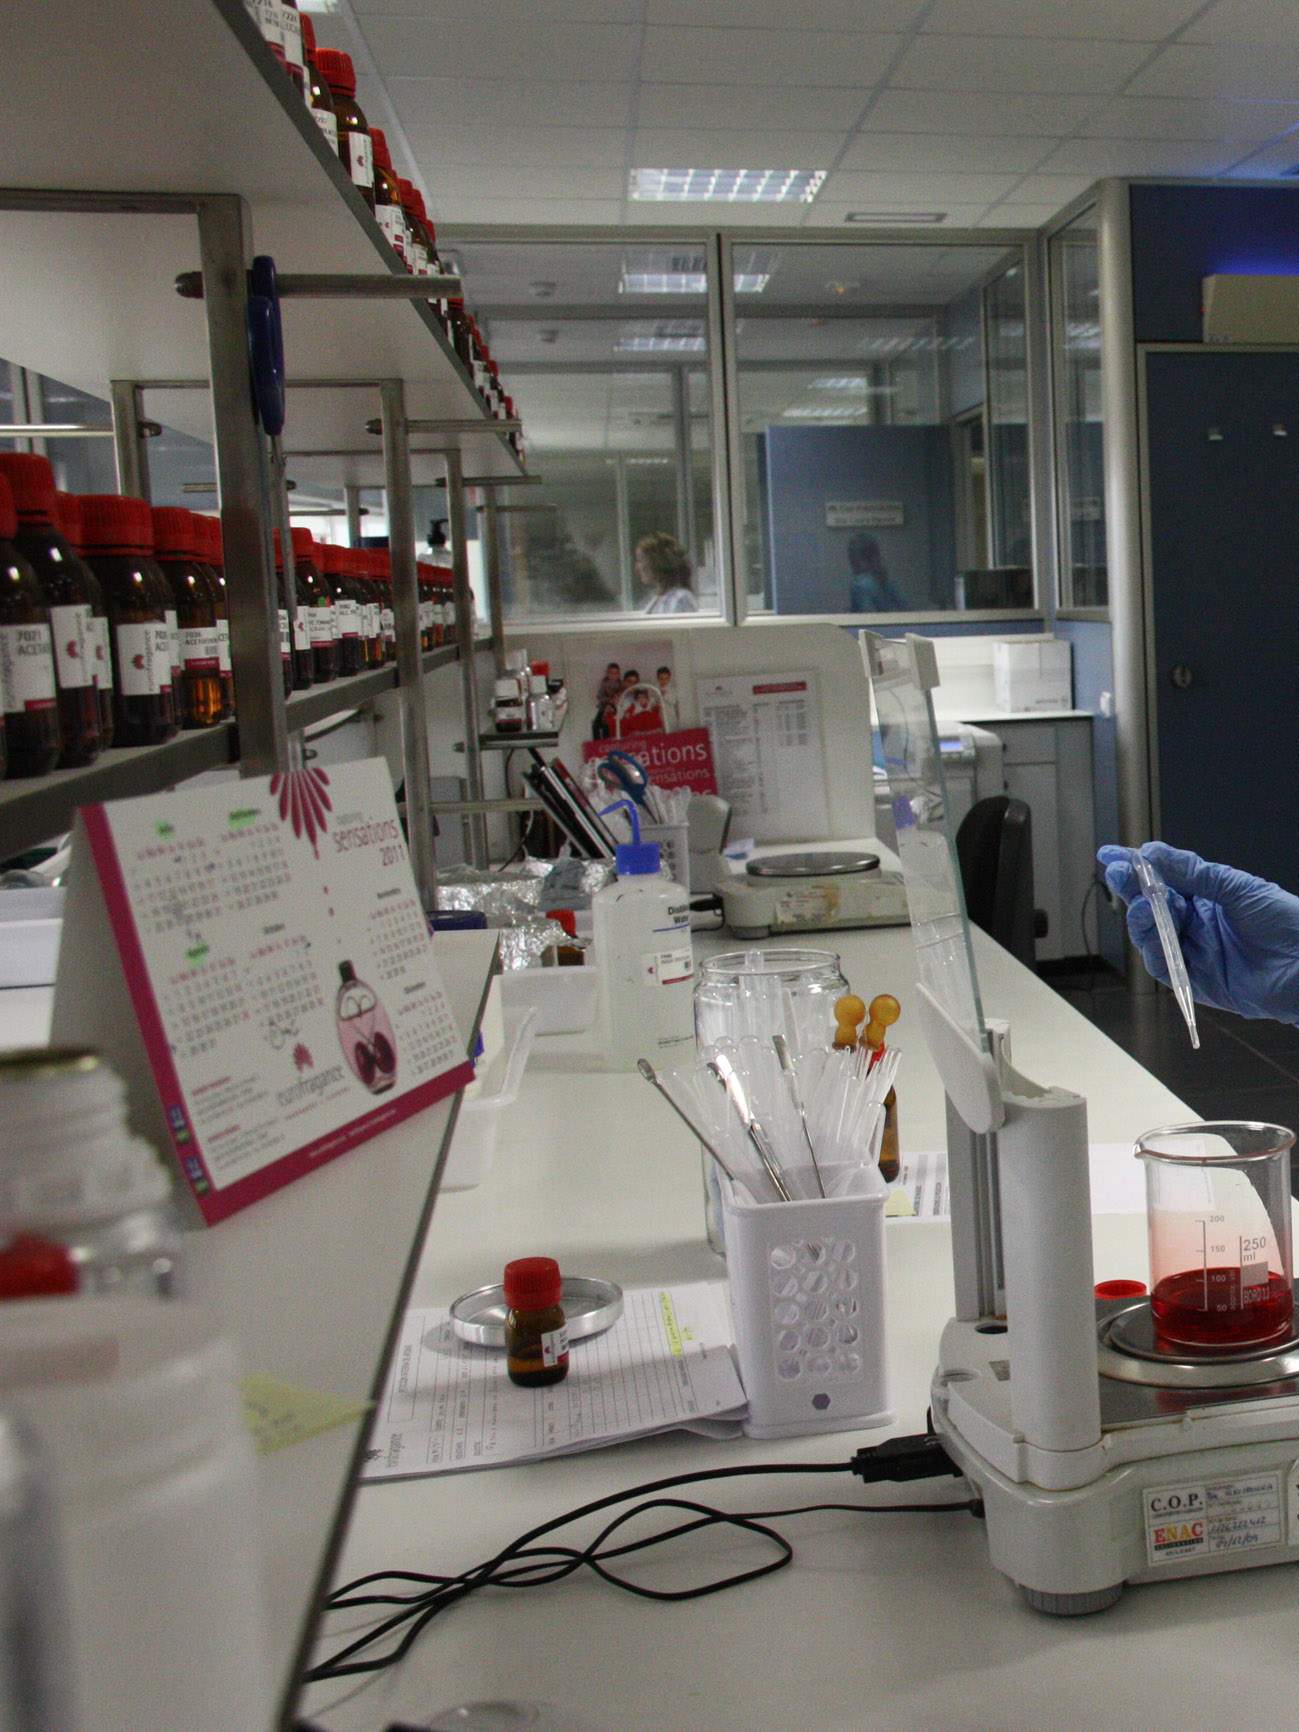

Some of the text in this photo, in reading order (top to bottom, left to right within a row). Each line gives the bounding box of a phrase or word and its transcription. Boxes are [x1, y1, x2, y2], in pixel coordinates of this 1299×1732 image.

[1209, 1215, 1225, 1223] 200
[1210, 1245, 1226, 1253] 150
[1243, 1237, 1267, 1251] 250
[1243, 1252, 1256, 1262] ml
[1216, 1304, 1228, 1312] 50
[1150, 1493, 1203, 1513] C.O.P.
[1153, 1521, 1204, 1544] ENAC
